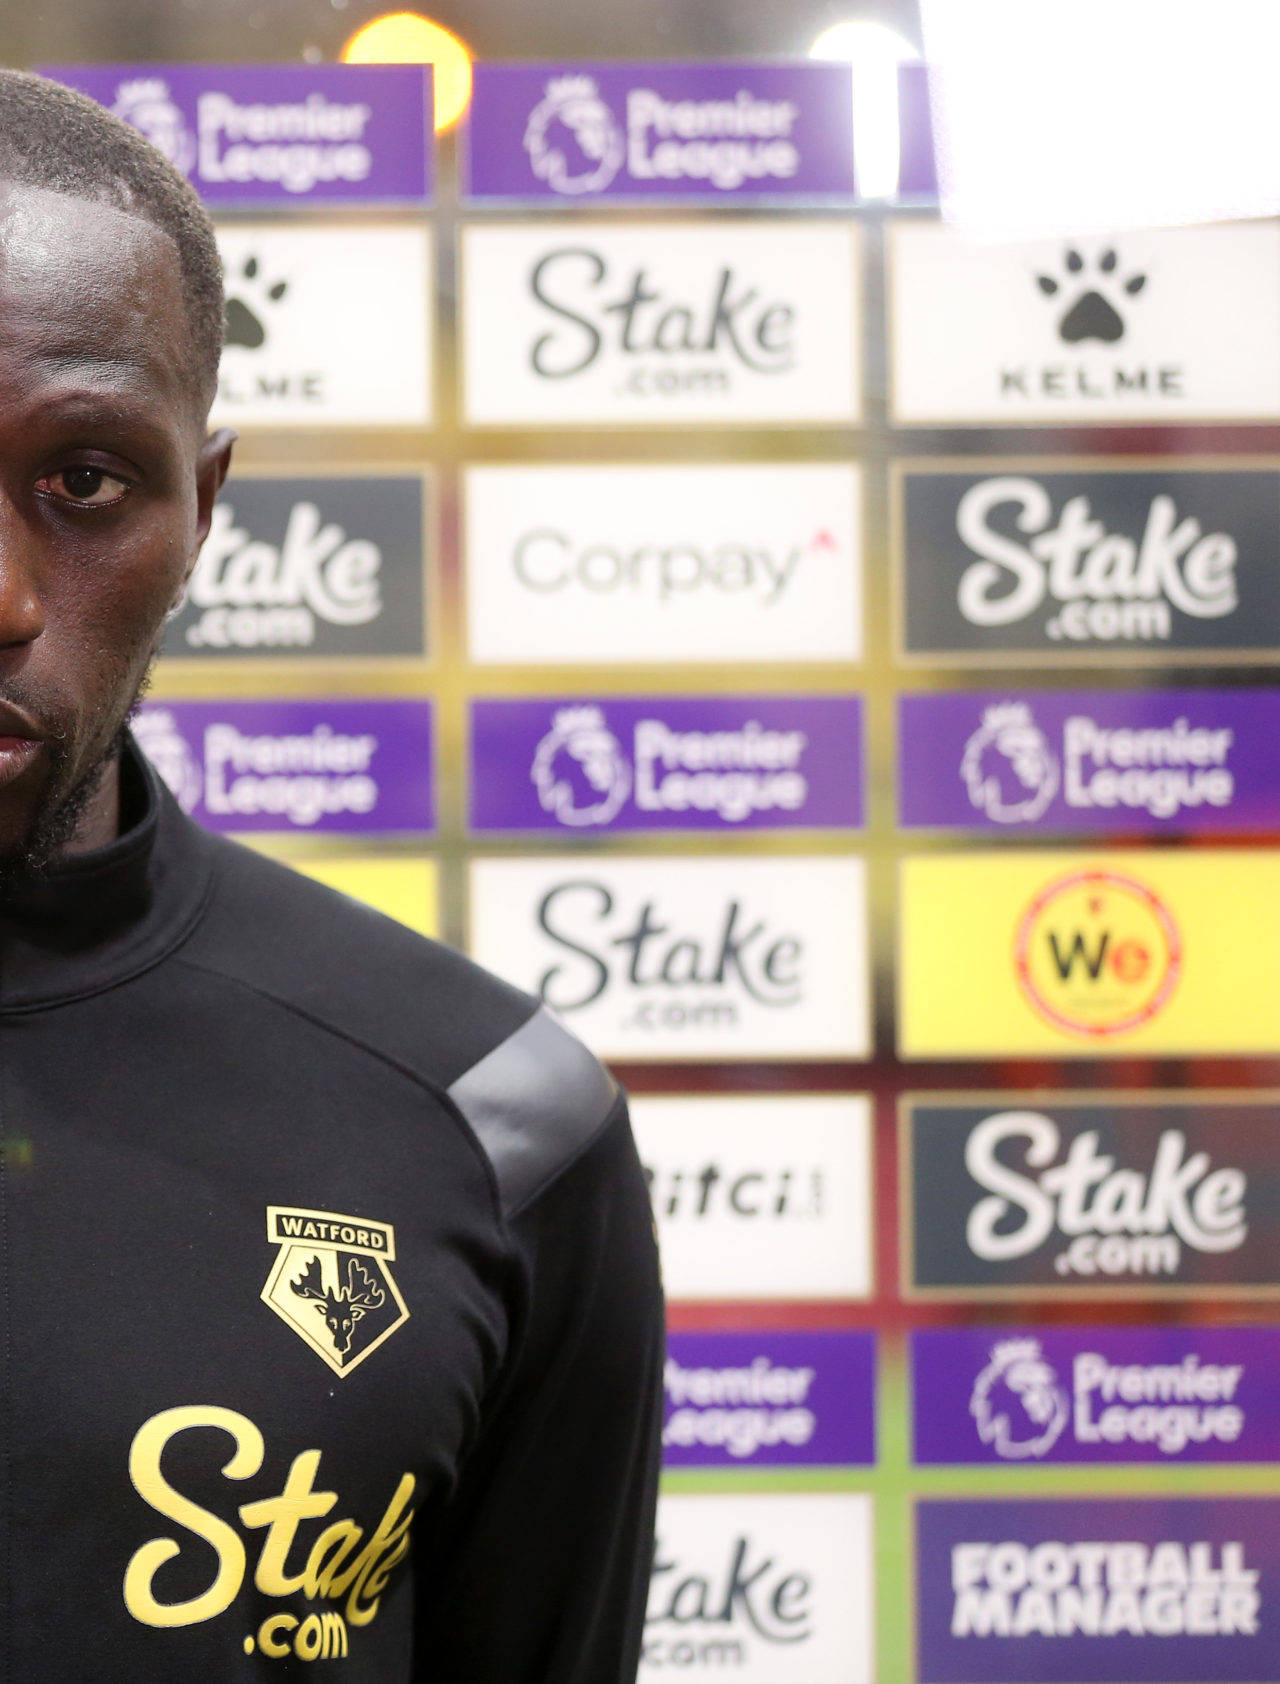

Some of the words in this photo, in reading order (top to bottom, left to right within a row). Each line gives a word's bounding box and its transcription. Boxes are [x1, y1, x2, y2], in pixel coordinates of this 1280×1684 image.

[198, 93, 369, 140] Premier
[627, 90, 797, 136] Premier
[198, 139, 370, 192] League
[627, 135, 798, 188] League
[528, 248, 796, 378] Stake
[222, 373, 325, 403] LME
[614, 366, 732, 397] .com
[1000, 366, 1183, 397] KELME
[189, 502, 382, 626] take
[511, 529, 800, 606] Corpay
[957, 478, 1238, 626] Stake
[185, 607, 317, 648] .com
[1047, 600, 1172, 641] .com
[204, 724, 375, 771] Premier
[635, 721, 805, 769] Premier
[1064, 717, 1233, 763] Premier
[204, 770, 376, 825] League
[635, 768, 806, 822] League
[1064, 762, 1234, 818] League
[535, 881, 804, 1012] Stake
[1047, 928, 1150, 985] We
[622, 999, 739, 1031] .com
[643, 1163, 791, 1217] itci
[966, 1112, 1247, 1261] Stake
[281, 1216, 384, 1249] WATFORD
[1055, 1235, 1181, 1276] .com
[665, 1356, 815, 1406] remier
[1073, 1353, 1243, 1400] Premier
[1073, 1399, 1244, 1453] League
[123, 1404, 416, 1627] Stake
[951, 1542, 1260, 1591] FOOTBALL
[243, 1612, 349, 1661] .com
[951, 1588, 1261, 1637] MANAGER
[644, 1640, 744, 1668] com
